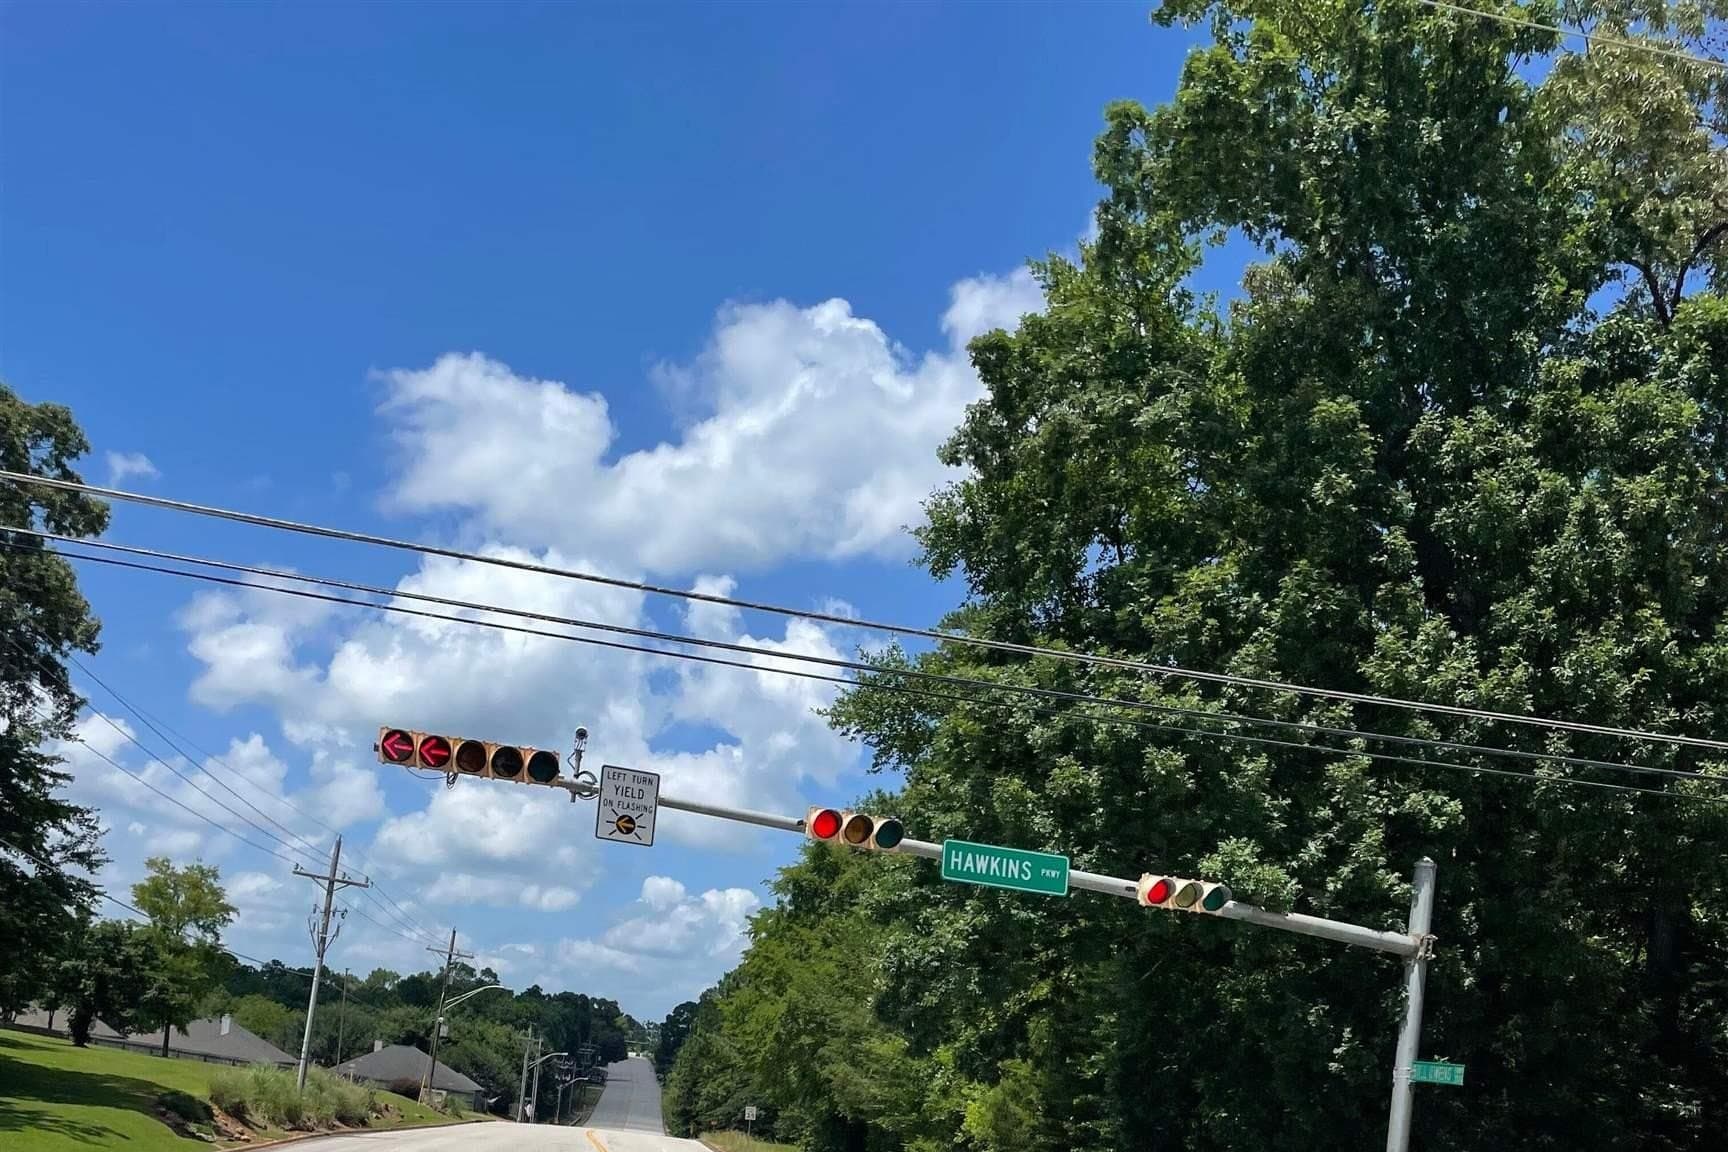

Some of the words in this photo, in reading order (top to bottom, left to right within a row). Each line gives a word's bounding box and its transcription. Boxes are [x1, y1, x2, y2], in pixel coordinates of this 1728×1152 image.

[607, 770, 627, 782] LEFT
[632, 775, 655, 786] TURN
[614, 784, 645, 800] YIELD
[603, 798, 614, 808] ON
[617, 800, 653, 814] FLASHING
[950, 849, 1032, 881] HAWKINS
[1040, 868, 1061, 879] PKWY
